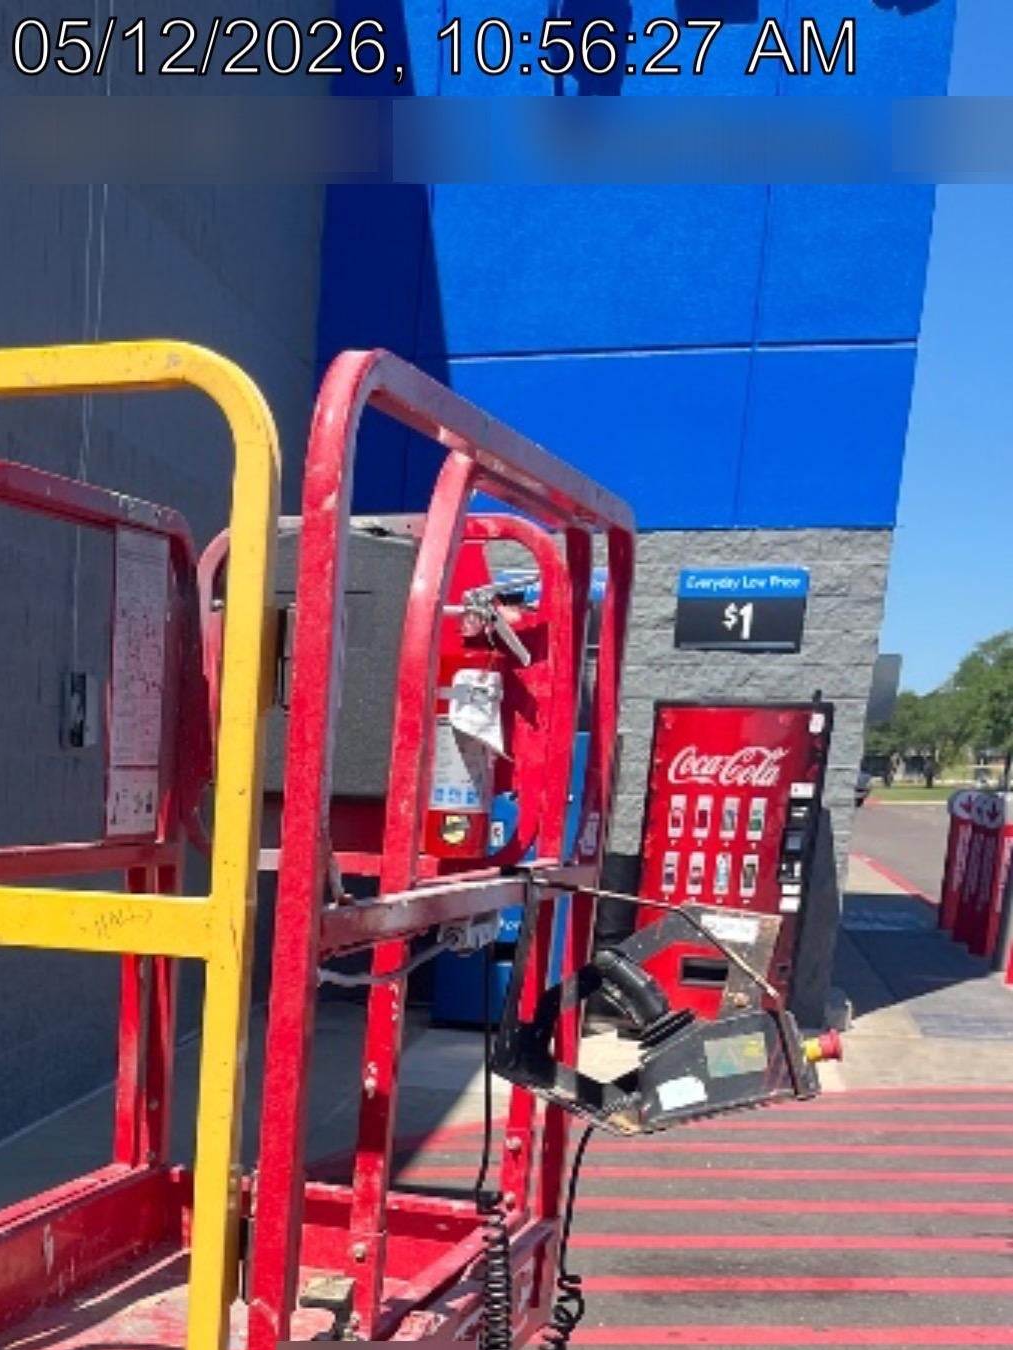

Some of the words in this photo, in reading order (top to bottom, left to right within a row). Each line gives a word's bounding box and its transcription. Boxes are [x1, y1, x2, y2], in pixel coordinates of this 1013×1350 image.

[686, 575, 740, 592] Everyday
[742, 575, 768, 589] Low
[769, 575, 801, 589] Price
[722, 602, 754, 640] $1
